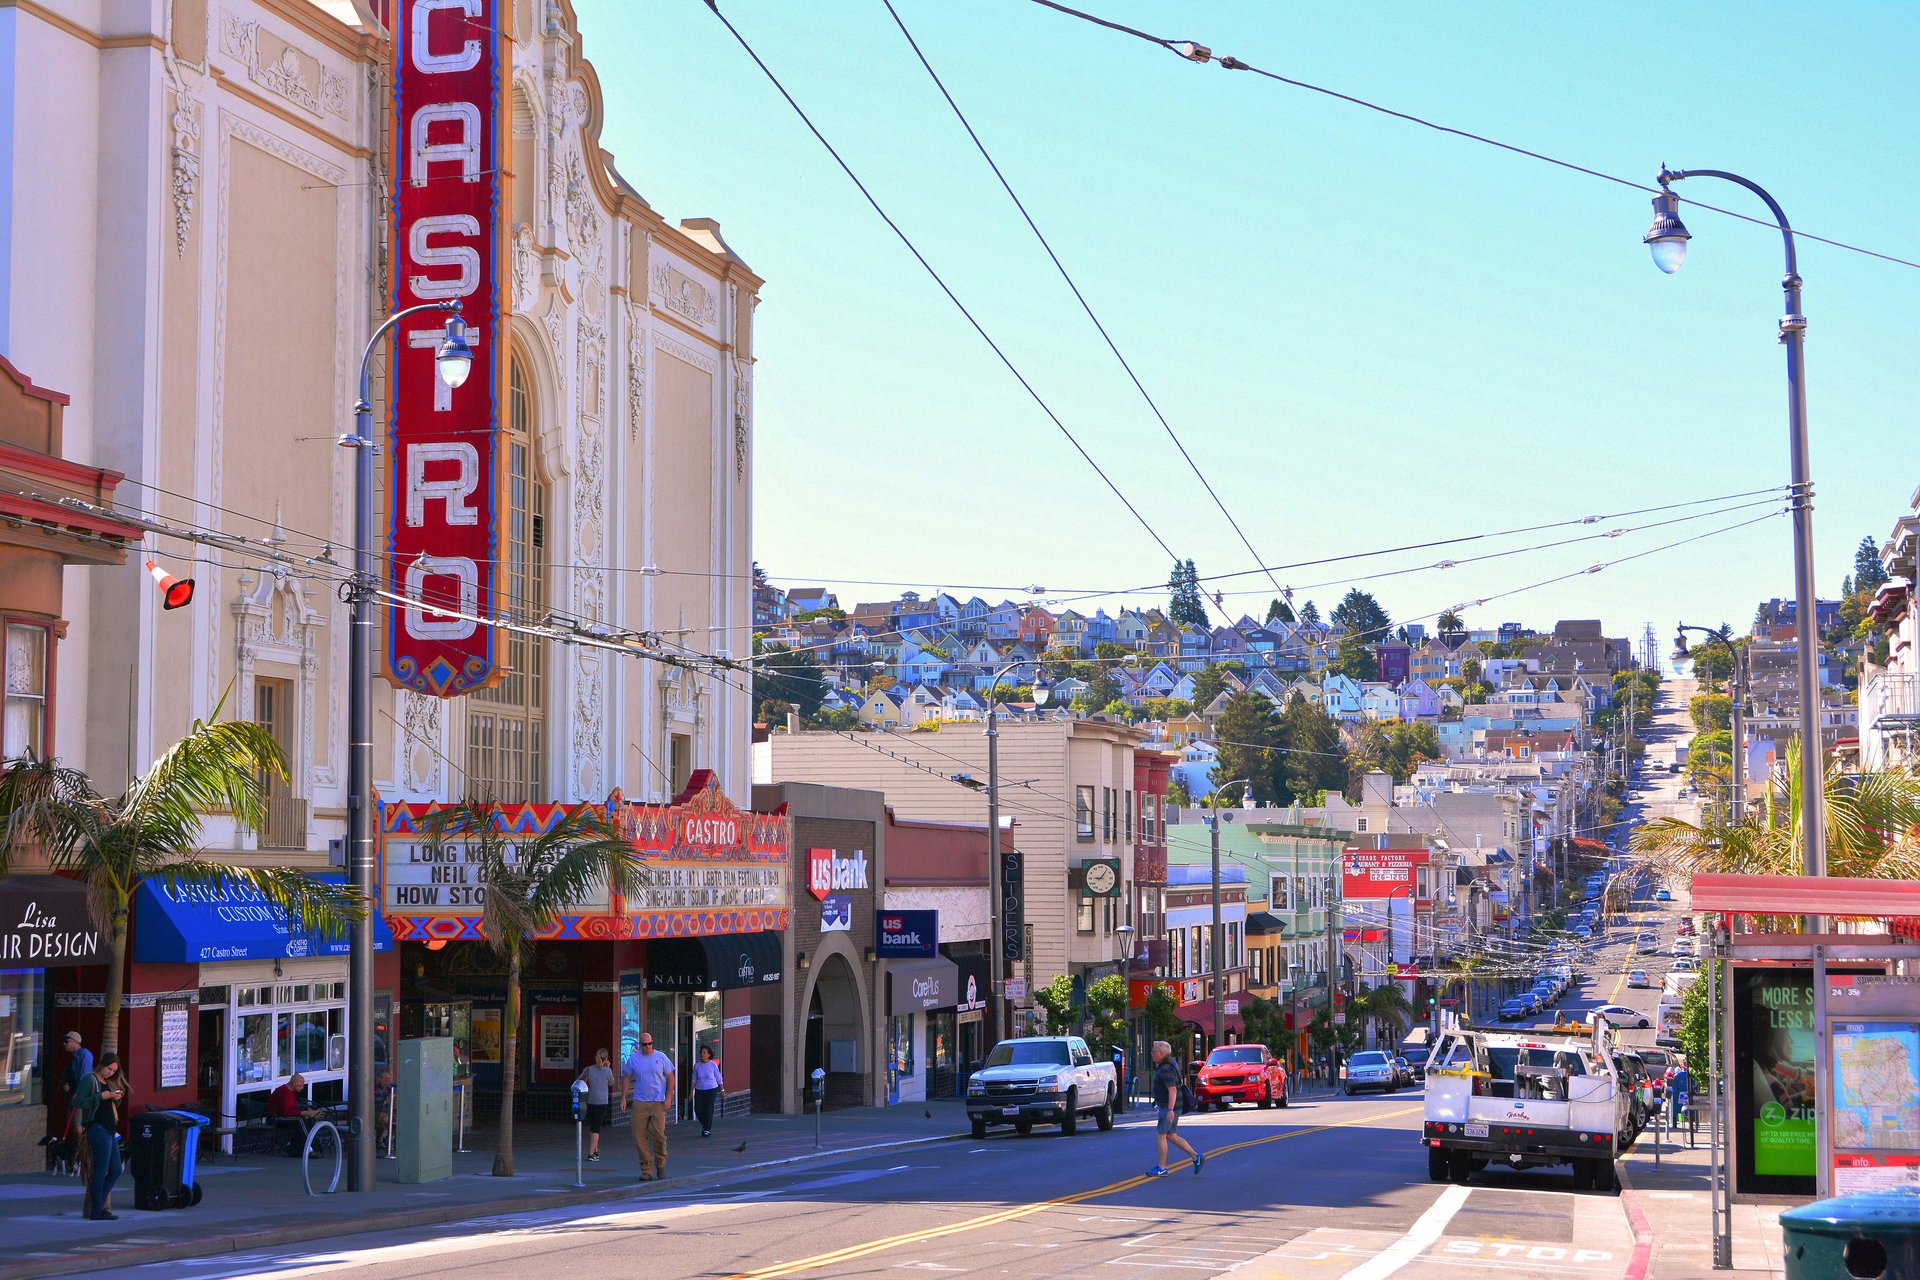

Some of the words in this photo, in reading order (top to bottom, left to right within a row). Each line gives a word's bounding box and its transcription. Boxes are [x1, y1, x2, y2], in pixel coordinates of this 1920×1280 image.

[404, 0, 483, 641] CASTRO
[686, 818, 736, 845] CASTRO
[410, 845, 457, 863] LONG
[431, 866, 467, 884] NEIL
[724, 870, 737, 886] FILM
[738, 870, 761, 886] FESTIVAL
[396, 887, 438, 905] HOW
[712, 888, 720, 905] OF
[17, 901, 57, 929] Lisa
[217, 906, 275, 922] CUSTOM
[1005, 854, 1020, 960] SLIDERS
[883, 919, 902, 929] us
[0, 934, 21, 959] IR
[29, 931, 98, 959] DESIGN
[882, 931, 921, 945] bank
[200, 948, 211, 959] 427
[212, 946, 230, 958] Castro
[231, 945, 248, 957] Street
[653, 974, 703, 985] NAILS
[912, 976, 940, 999] CarePlus
[1762, 987, 1799, 1010] MORE
[1831, 988, 1843, 997] 24
[1770, 1010, 1803, 1028] LESS
[1846, 1024, 1865, 1033] map
[1790, 1131, 1806, 1139] FREE
[1852, 1156, 1869, 1167] info
[1442, 1240, 1613, 1263] STOP
